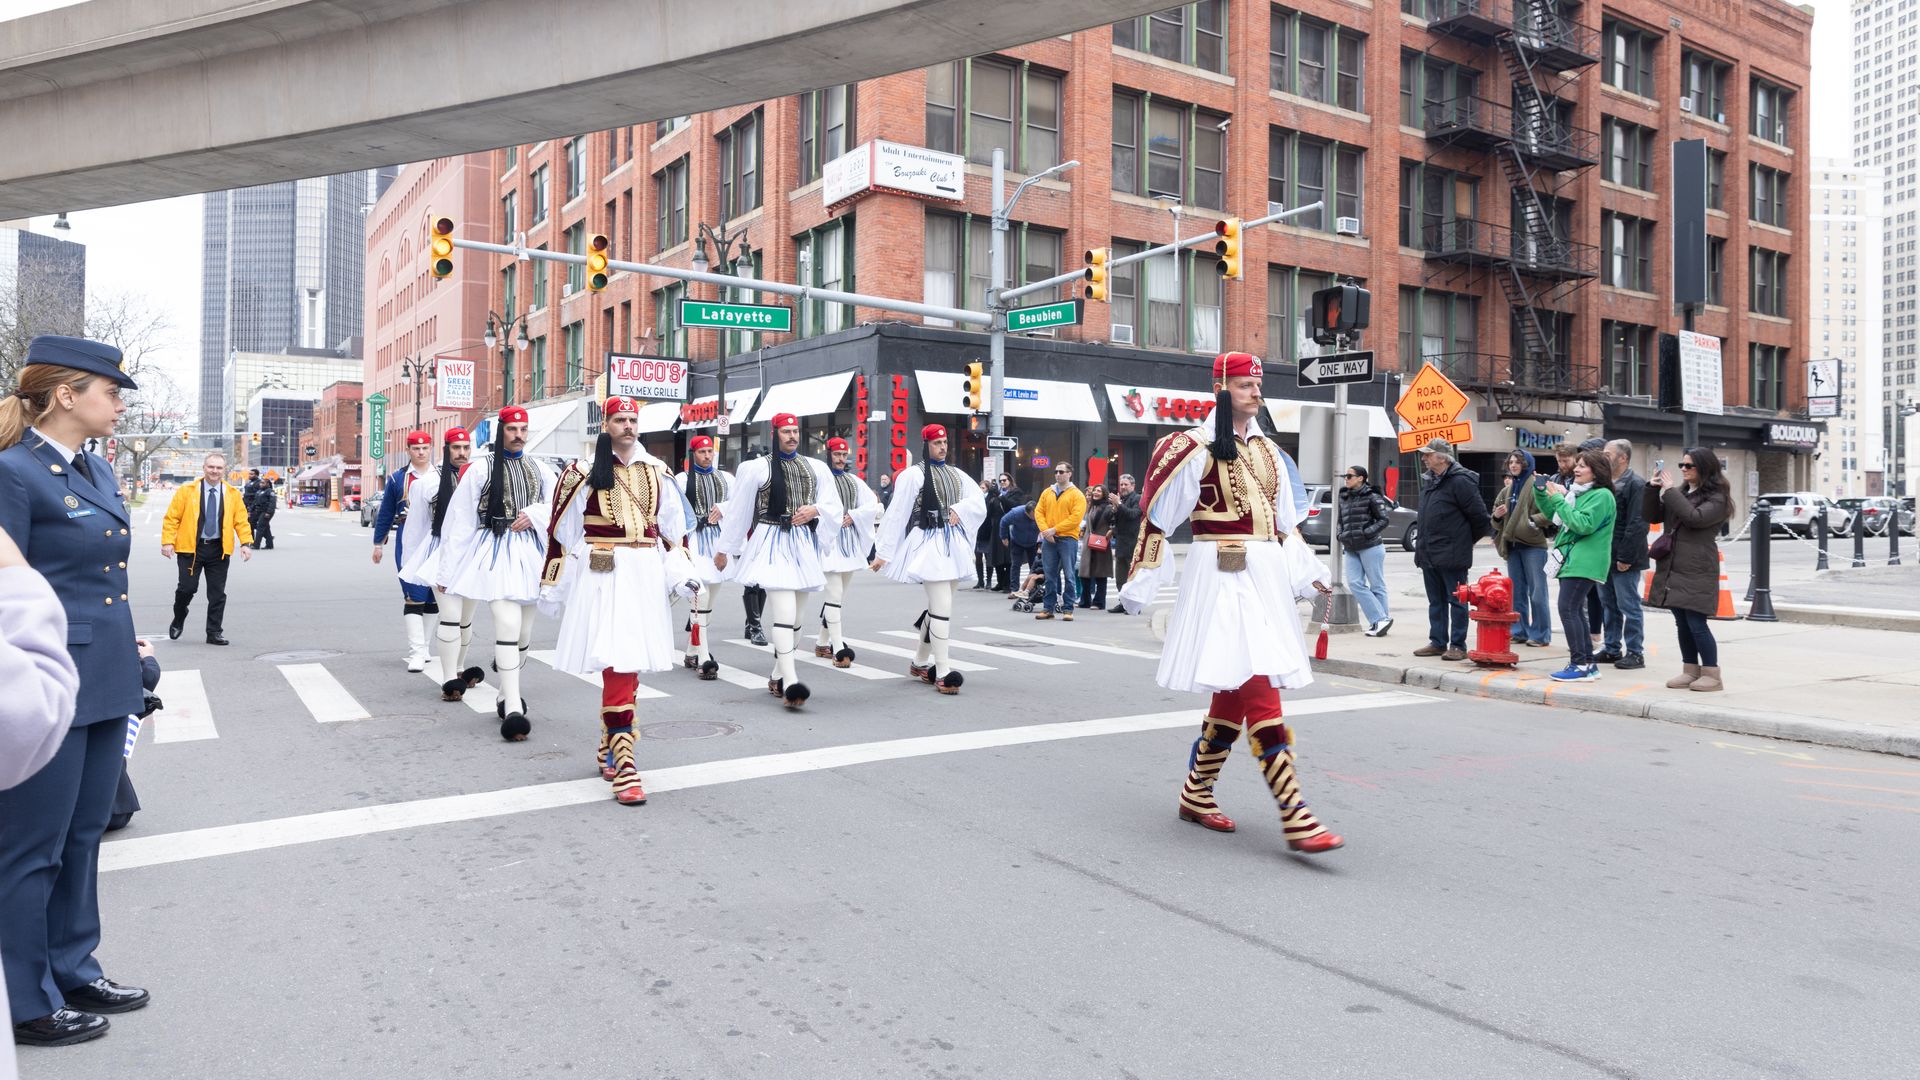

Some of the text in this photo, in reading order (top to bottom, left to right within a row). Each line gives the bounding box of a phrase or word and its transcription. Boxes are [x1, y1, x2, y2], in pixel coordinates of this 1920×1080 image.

[882, 145, 953, 166] Adult Entertainment
[893, 165, 948, 183] Bouzouki Club
[701, 307, 773, 324] Lafayette
[1019, 310, 1062, 325] Beaubien
[1694, 335, 1719, 351] PARKING
[617, 359, 681, 384] LOCO'S
[1319, 361, 1365, 376] ONE WAY
[620, 384, 679, 398] TEX MEX GRILLE
[1416, 385, 1443, 397] ROAD
[1417, 399, 1445, 411] WORK
[1416, 413, 1449, 425] AHEAD
[373, 404, 381, 455] PARKING
[1415, 429, 1454, 446] BRUSH
[1771, 424, 1817, 442] BOUZOUKI
[1032, 457, 1049, 466] OPEN
